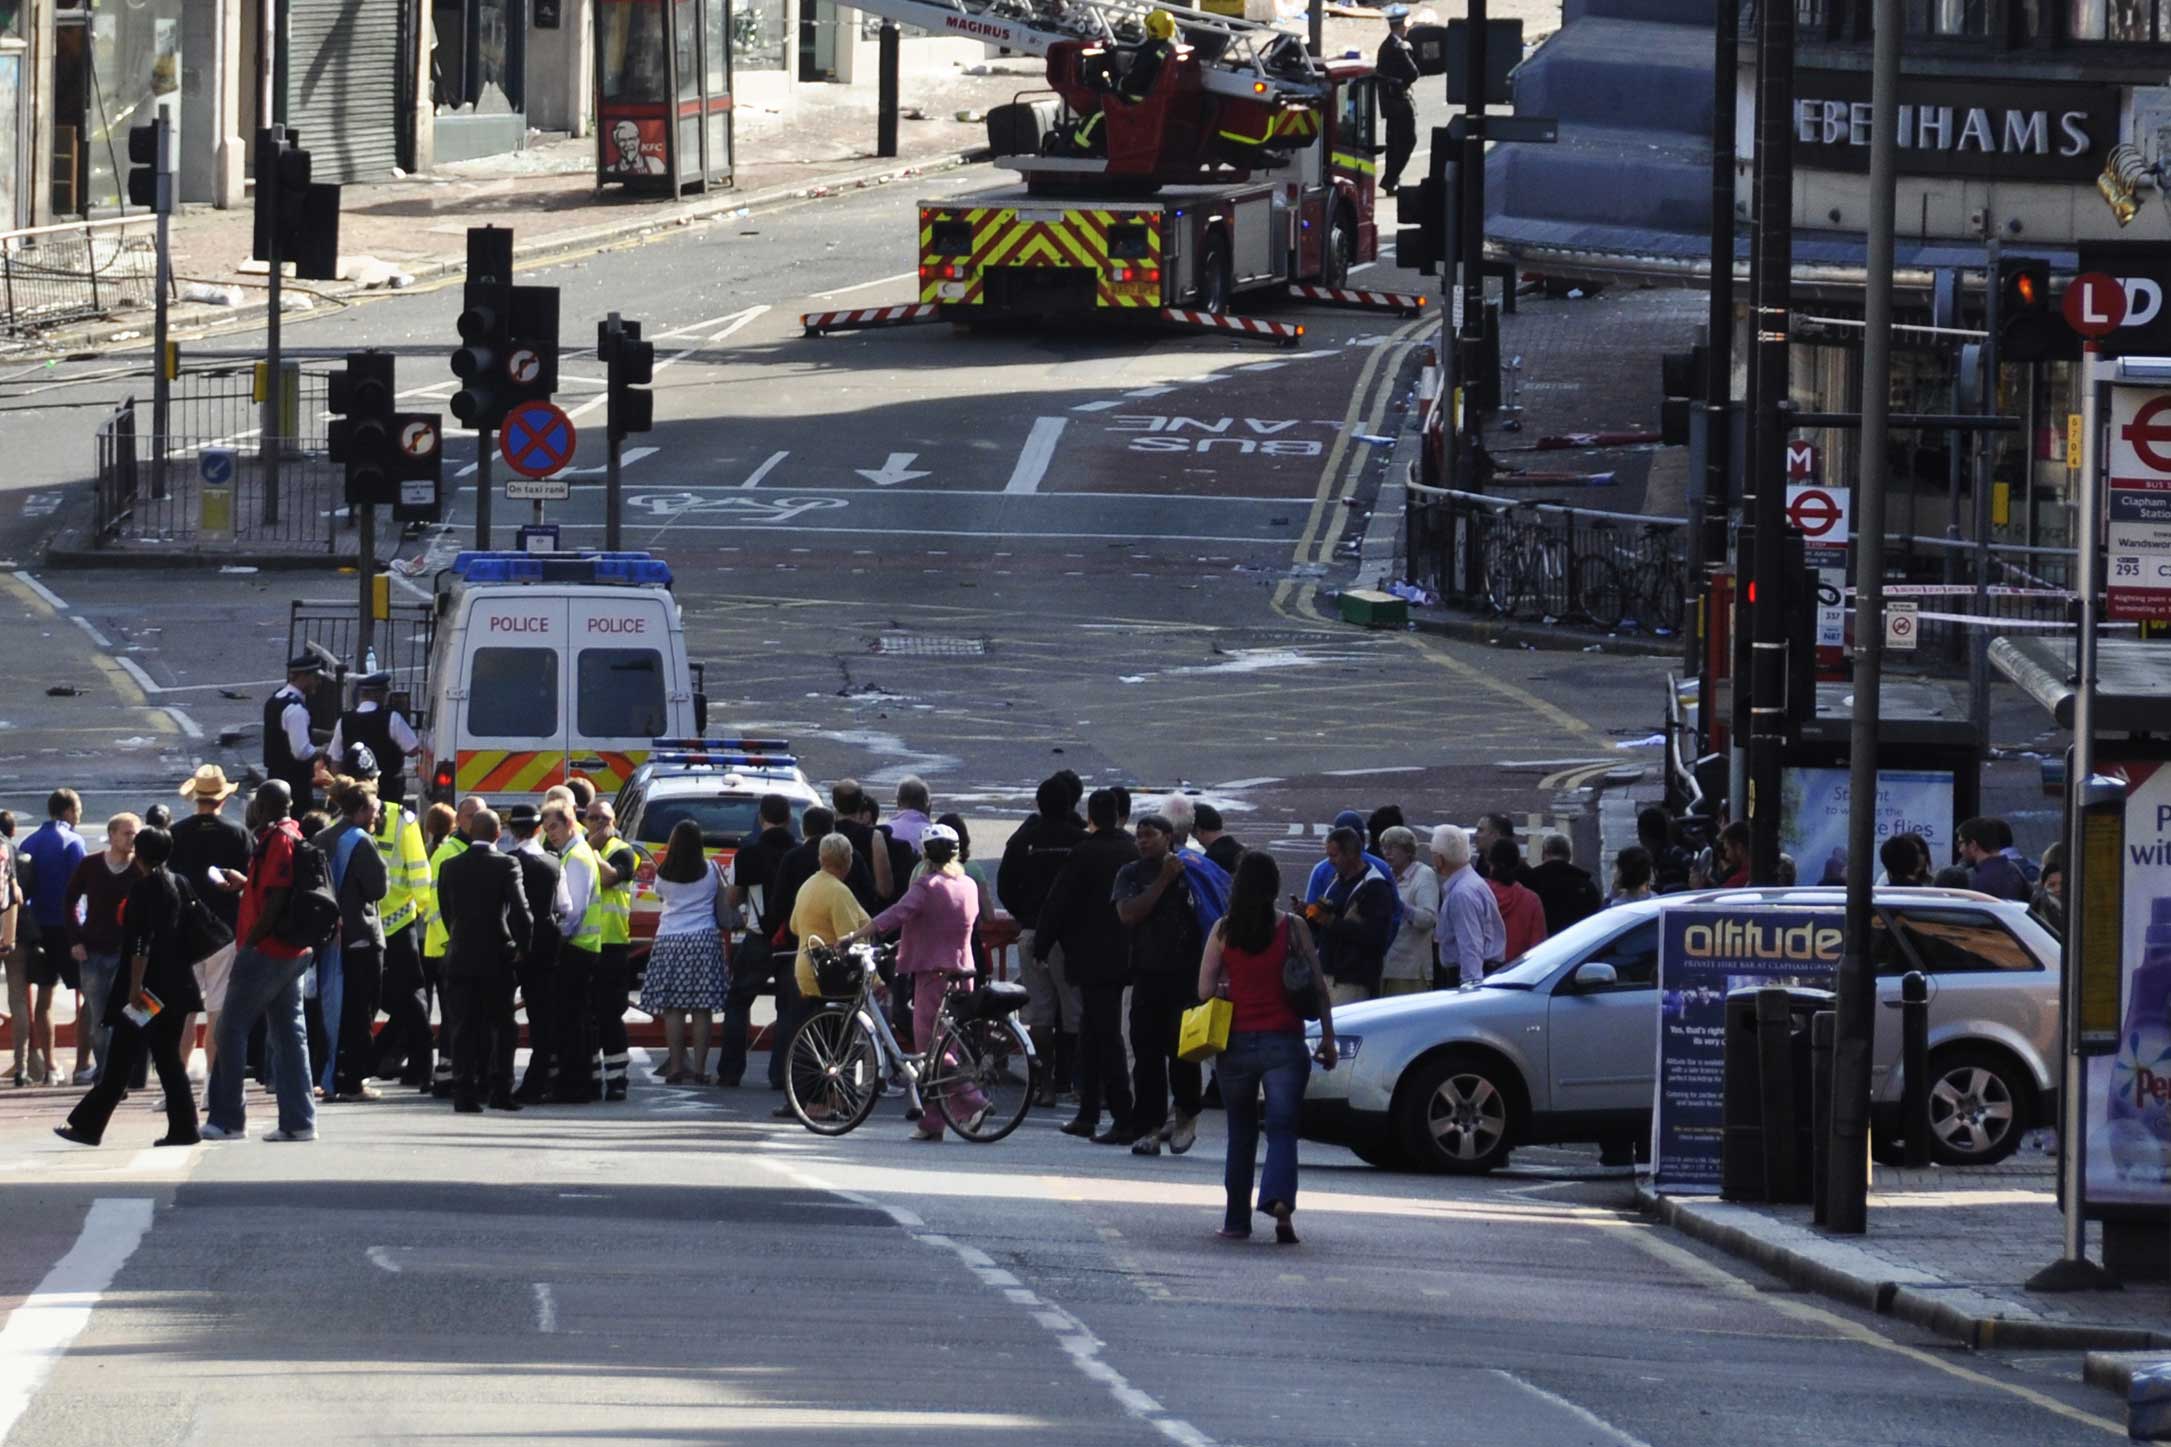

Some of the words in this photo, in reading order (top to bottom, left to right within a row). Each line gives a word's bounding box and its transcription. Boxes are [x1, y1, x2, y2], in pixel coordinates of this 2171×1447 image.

[946, 16, 1010, 40] MAGIRUS
[1793, 98, 2091, 157] EBEHAMS
[641, 142, 663, 152] KFC
[2083, 283, 2109, 323] L
[1128, 436, 1323, 456] BUS
[1787, 447, 1812, 472] M
[508, 484, 522, 494] On
[524, 484, 543, 494] taxi
[545, 485, 566, 494] rank
[2121, 495, 2167, 508] Clapham
[2115, 564, 2140, 577] 295
[490, 616, 549, 633] POLICE
[587, 617, 645, 633] POLICE
[1825, 806, 1838, 816] to
[1885, 807, 1904, 816] the
[1895, 819, 1934, 838] flies
[1684, 918, 1843, 960] altitude
